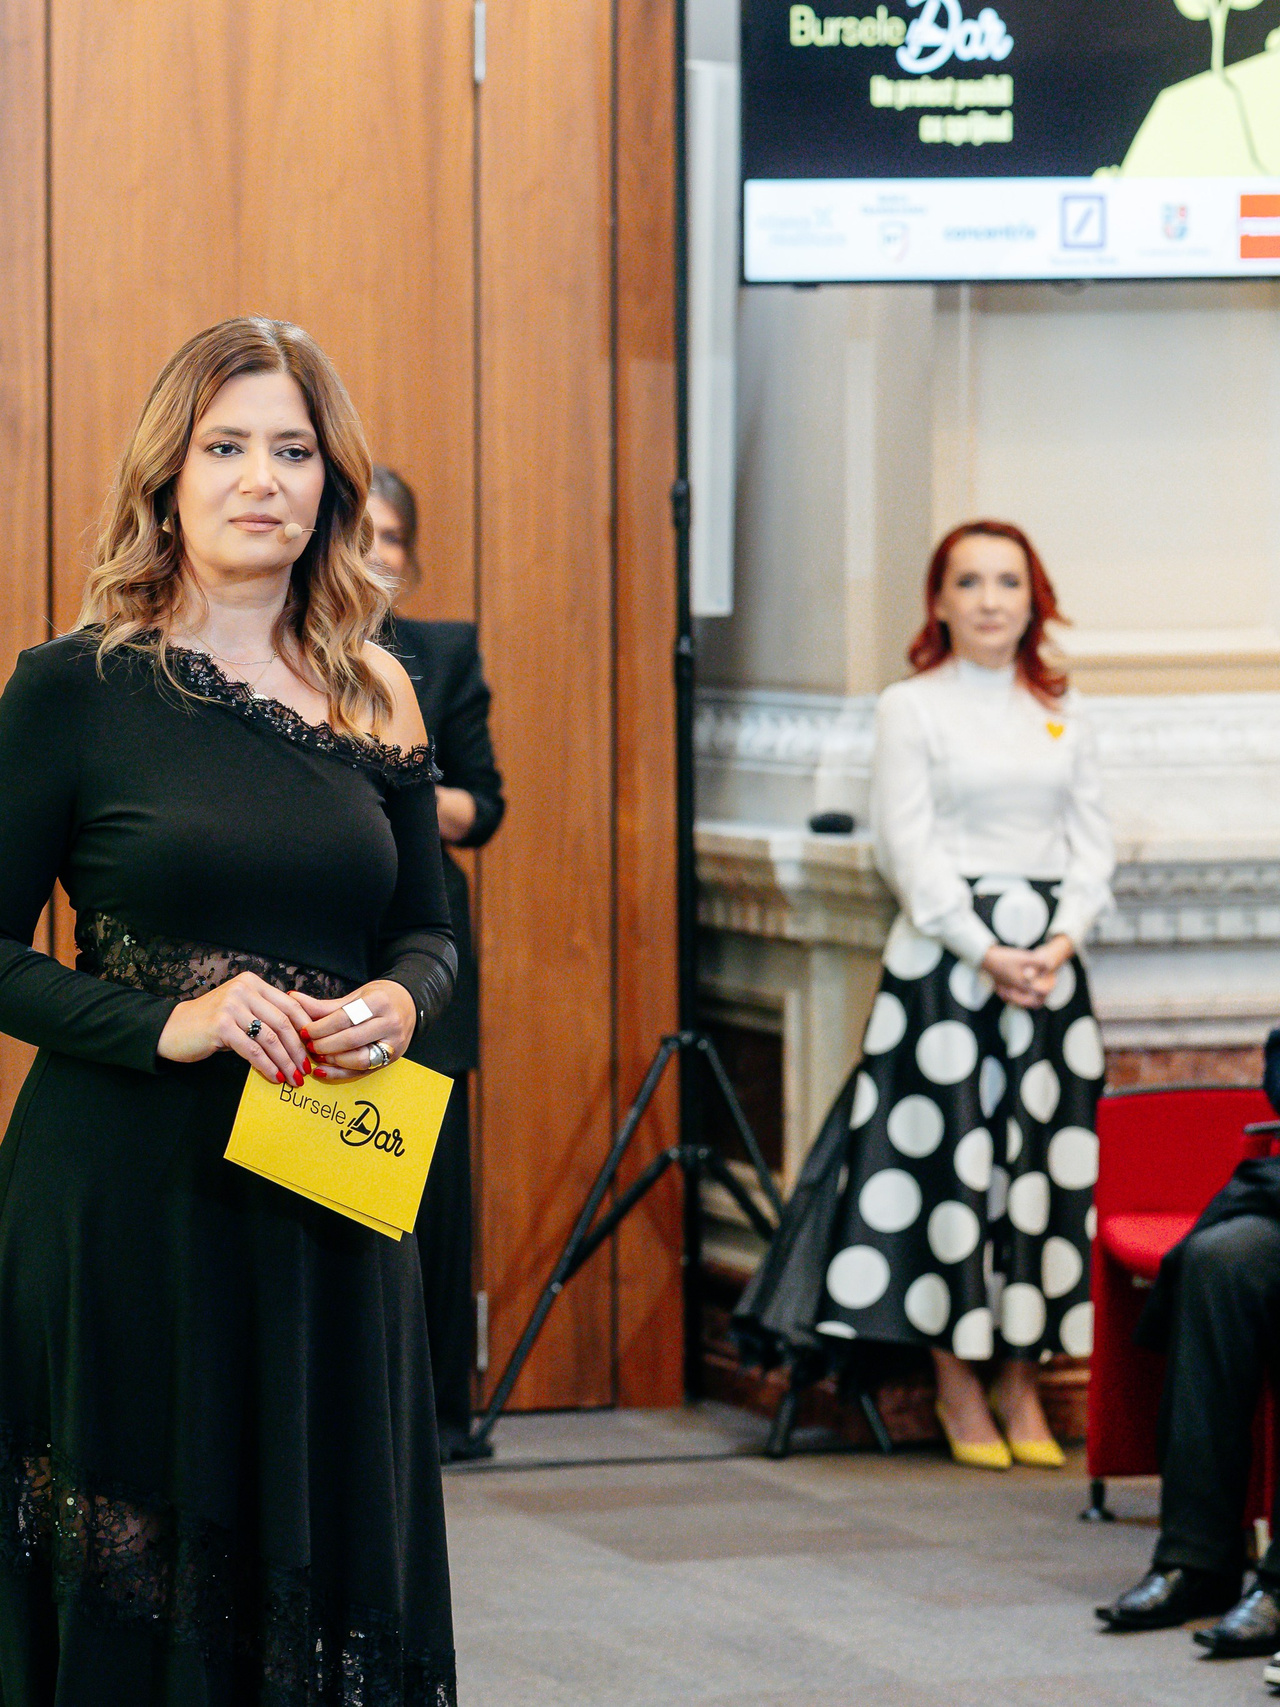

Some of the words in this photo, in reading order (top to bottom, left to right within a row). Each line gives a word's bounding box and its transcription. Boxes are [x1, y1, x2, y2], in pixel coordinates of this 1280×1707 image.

[789, 4, 907, 47] Bursele
[896, 0, 1014, 74] Dar
[279, 1081, 347, 1125] Bursele
[340, 1100, 406, 1157] Dar
